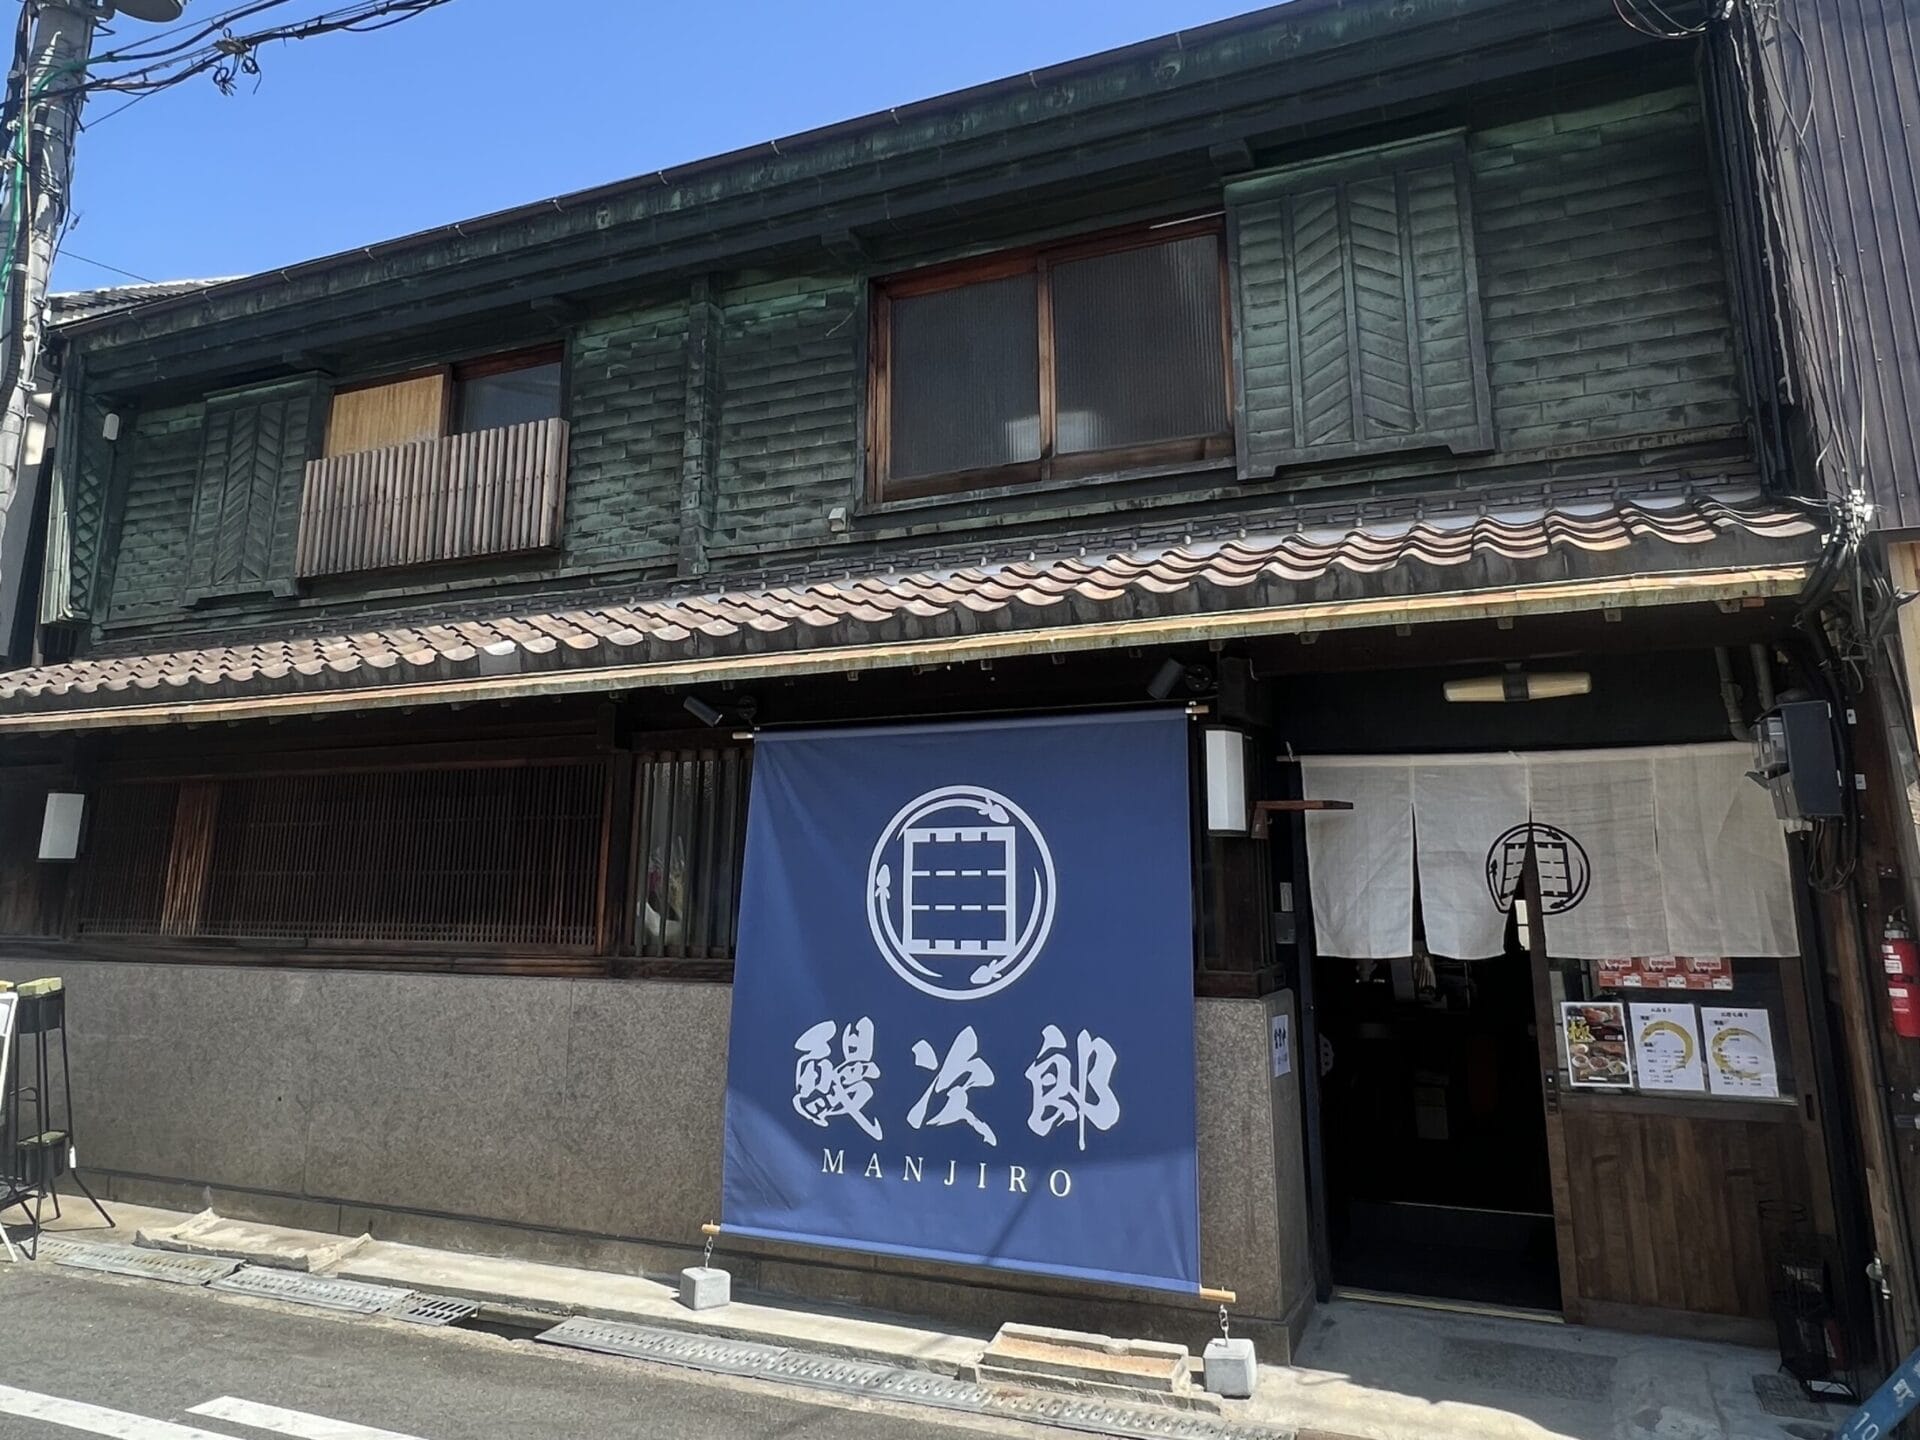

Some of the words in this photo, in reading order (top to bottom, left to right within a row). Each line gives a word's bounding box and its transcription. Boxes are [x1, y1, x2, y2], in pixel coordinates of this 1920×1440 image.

[793, 1016, 1120, 1151] 鰻次郎
[822, 1148, 1072, 1197] MANJIRO
[1854, 1412, 1880, 1440] 10
